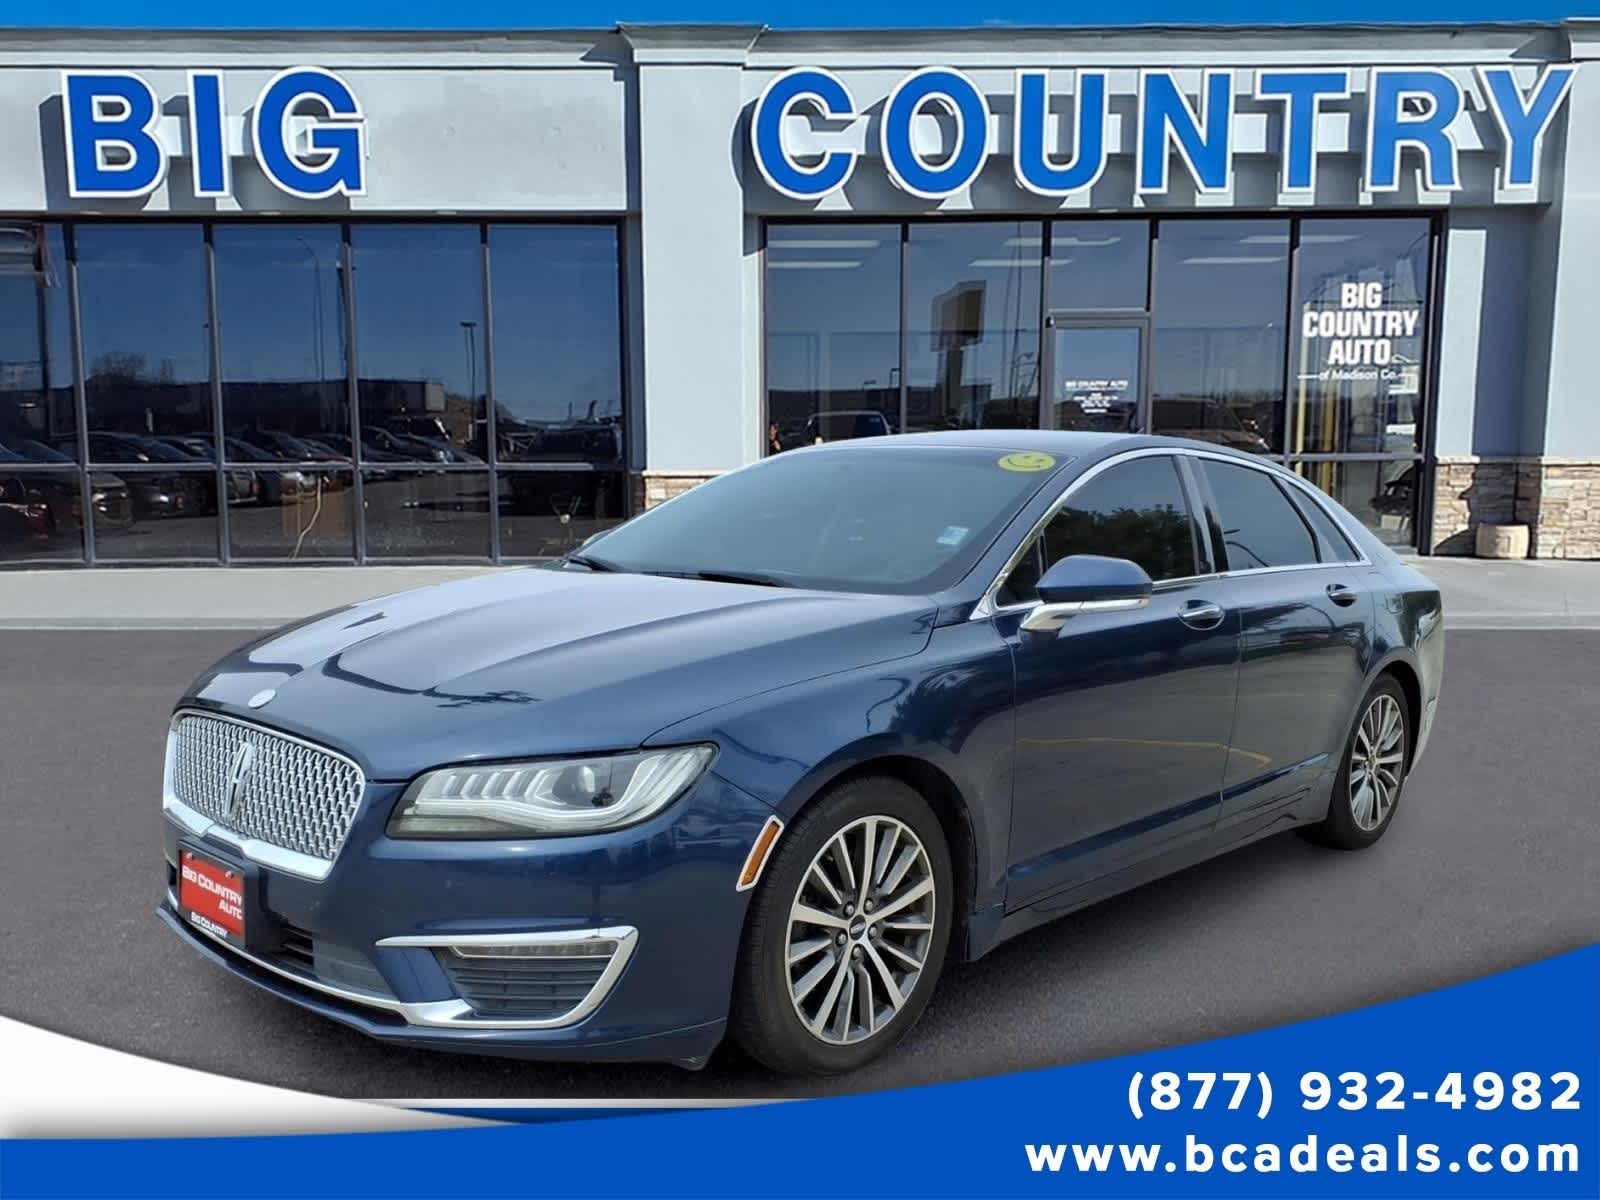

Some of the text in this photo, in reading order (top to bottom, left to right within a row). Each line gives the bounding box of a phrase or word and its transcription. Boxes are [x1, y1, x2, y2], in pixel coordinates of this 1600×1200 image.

[61, 66, 1575, 200] BIG COUNTRY
[1341, 282, 1382, 310] BIG
[1302, 310, 1419, 338] COUNTRY
[1328, 339, 1391, 366] AUTO
[1332, 368, 1378, 380] Madison
[182, 865, 242, 906] BIG COUNTRY
[218, 899, 243, 920] AUTO
